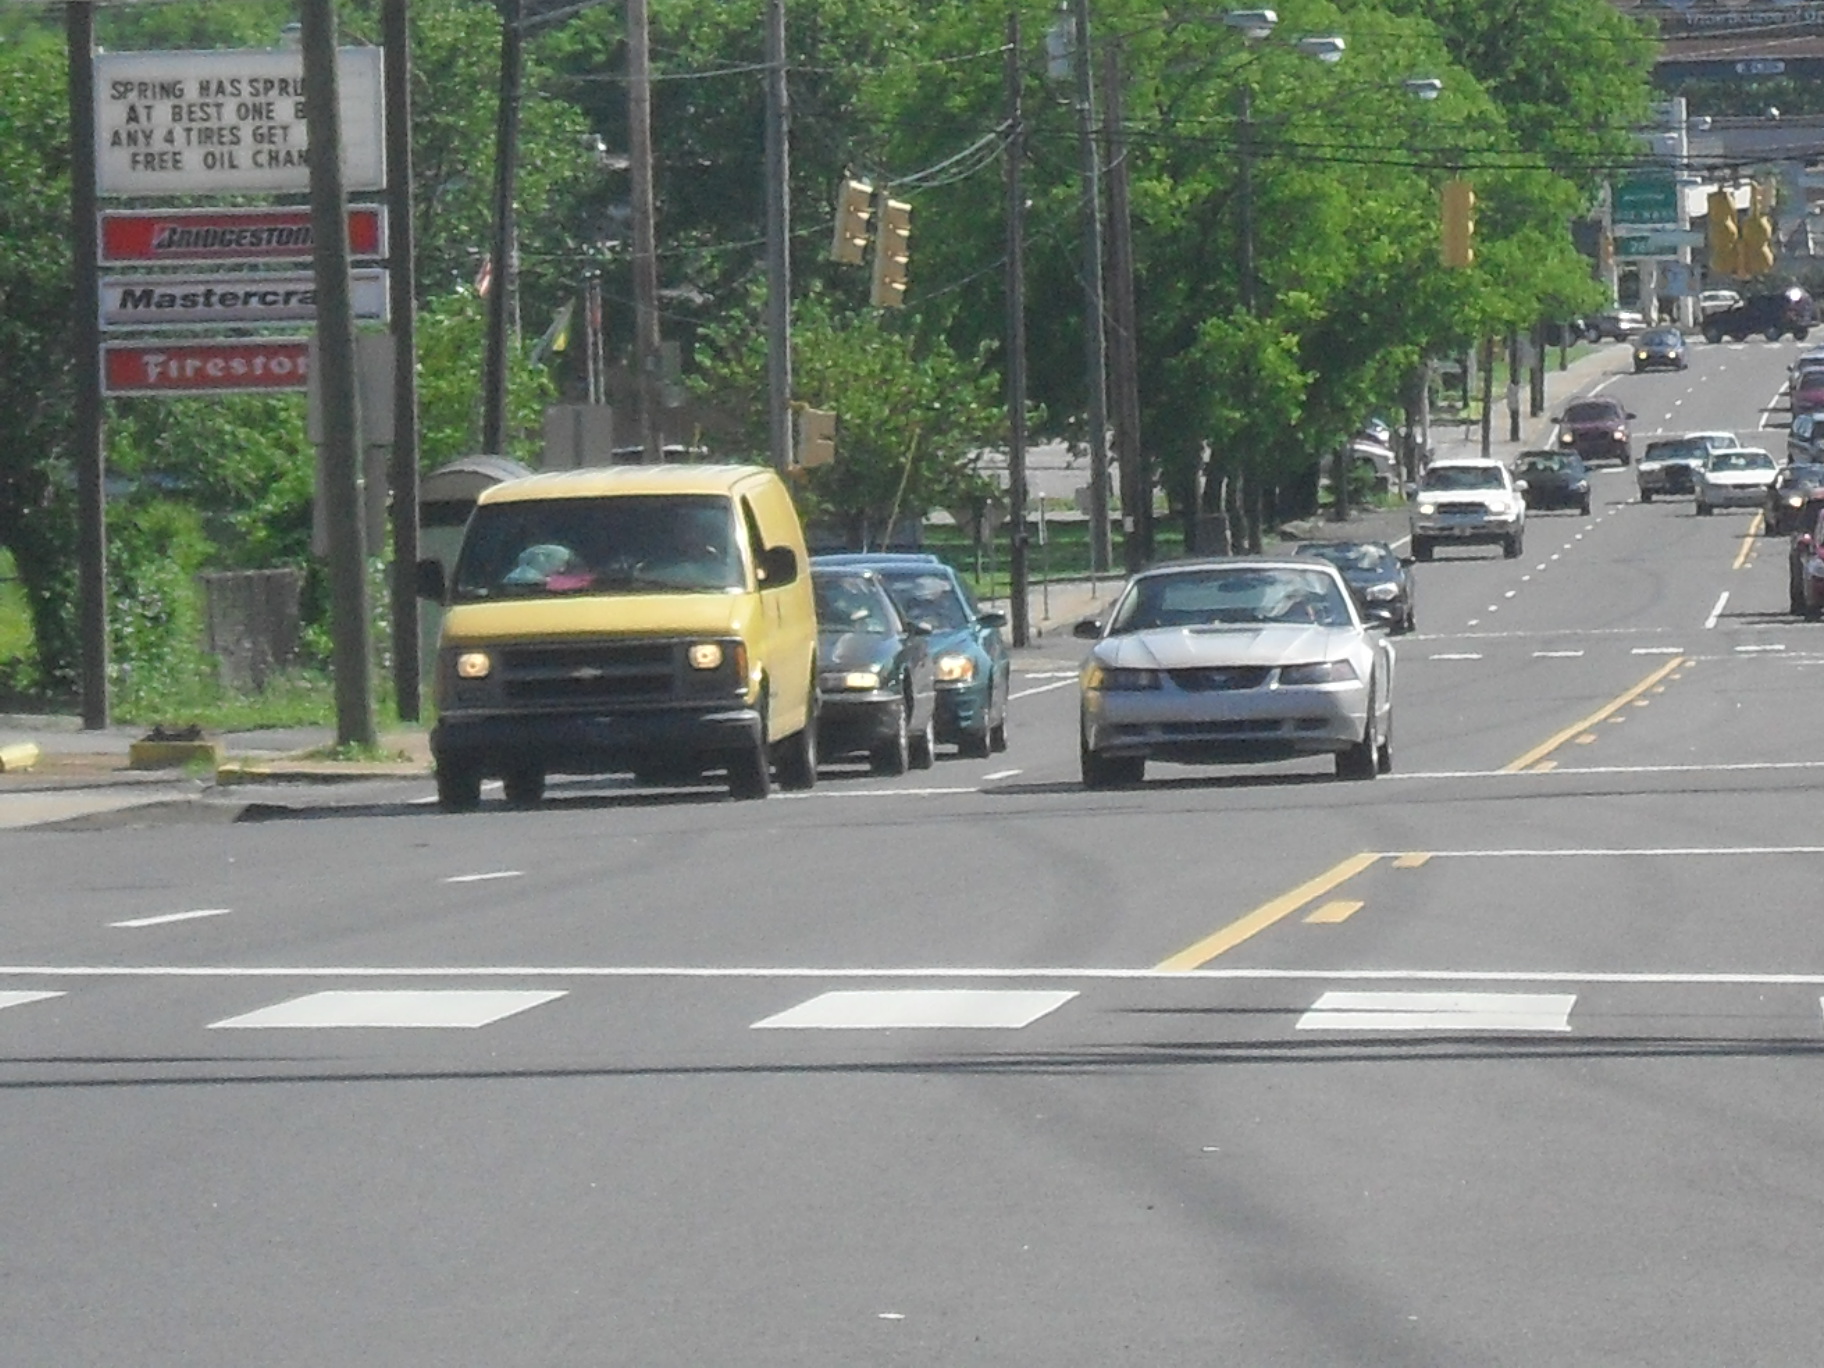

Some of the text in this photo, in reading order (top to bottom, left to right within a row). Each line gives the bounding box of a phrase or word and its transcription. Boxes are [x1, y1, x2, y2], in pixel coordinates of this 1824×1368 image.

[110, 77, 305, 101] SPRING HAS SPRU
[126, 103, 155, 125] AT
[170, 101, 225, 123] BEST
[236, 100, 276, 122] ONE
[110, 124, 290, 148] ANY 4 TIRES GET
[131, 150, 184, 171] FREE
[203, 149, 240, 170] OIL
[154, 225, 314, 250] BRIDGESTON
[119, 287, 318, 310] Mastercra
[143, 352, 307, 383] Firesto
